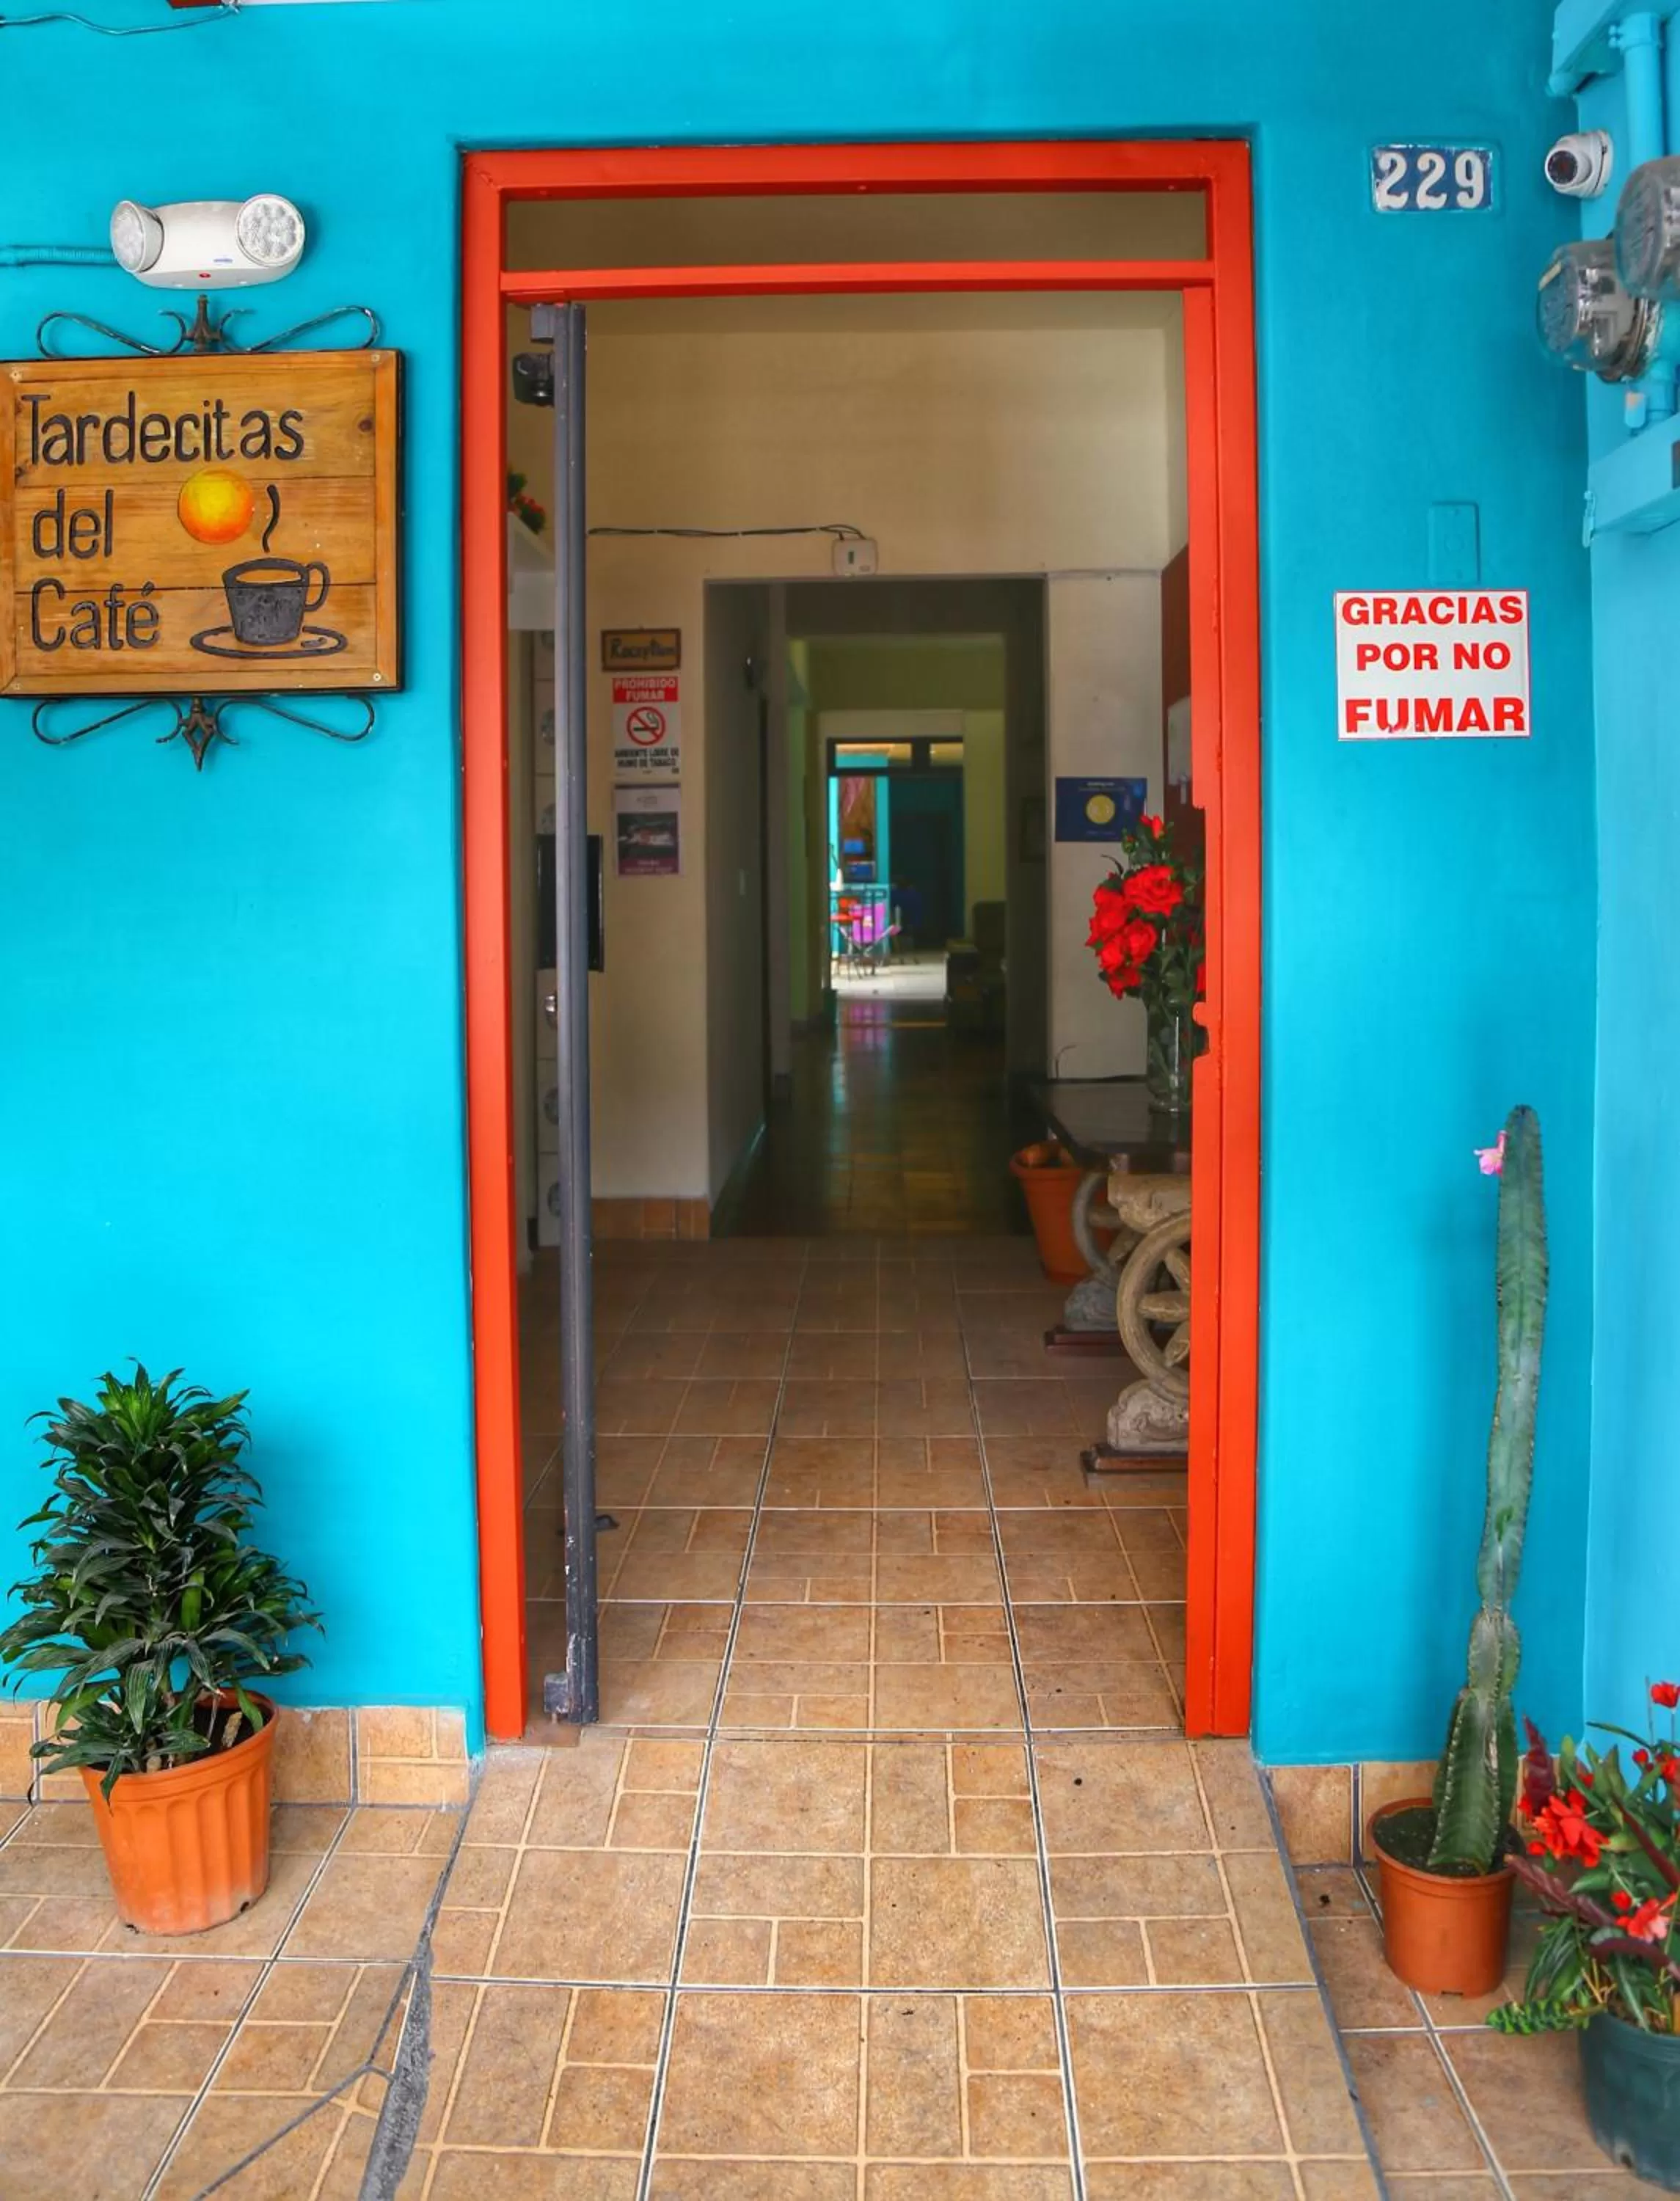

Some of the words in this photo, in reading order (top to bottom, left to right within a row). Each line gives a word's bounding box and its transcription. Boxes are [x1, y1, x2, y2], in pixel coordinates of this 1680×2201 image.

[1376, 150, 1484, 209] 229
[21, 390, 304, 466] Tardecitas
[32, 488, 114, 559] del
[32, 577, 160, 651] Café
[1342, 595, 1524, 625] GRACIAS
[1356, 643, 1439, 671] POR
[1453, 641, 1511, 670] NO
[615, 676, 676, 689] PROHIBIDO
[625, 690, 665, 701] FUMAR
[1345, 697, 1526, 733] FUMAR
